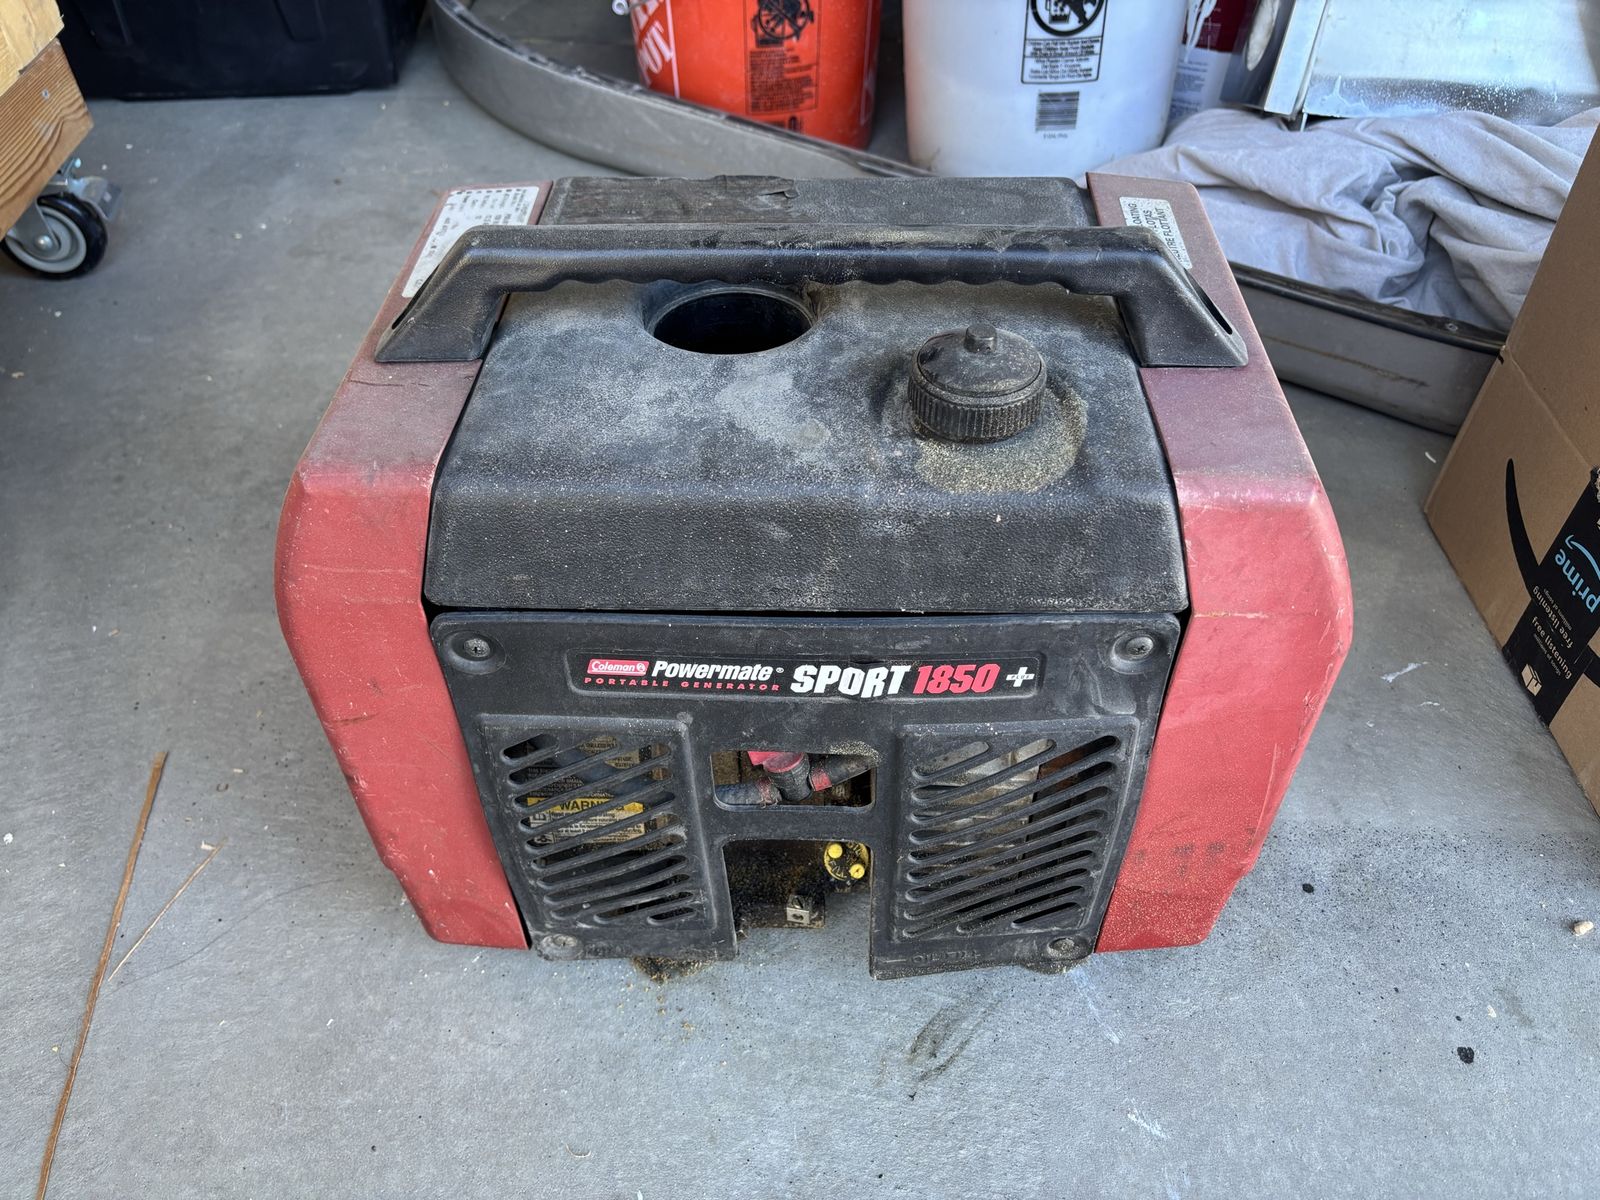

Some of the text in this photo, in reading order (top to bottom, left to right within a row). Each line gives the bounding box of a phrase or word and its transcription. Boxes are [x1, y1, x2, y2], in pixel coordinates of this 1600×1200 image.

[1555, 549, 1600, 613] prime
[1532, 585, 1573, 649] free listening
[1532, 616, 1573, 680] free listening
[584, 677, 780, 691] PORTABLE GENERATOR
[591, 661, 636, 671] Coleman
[790, 664, 912, 698] SPORT
[913, 663, 1001, 694] 1850
